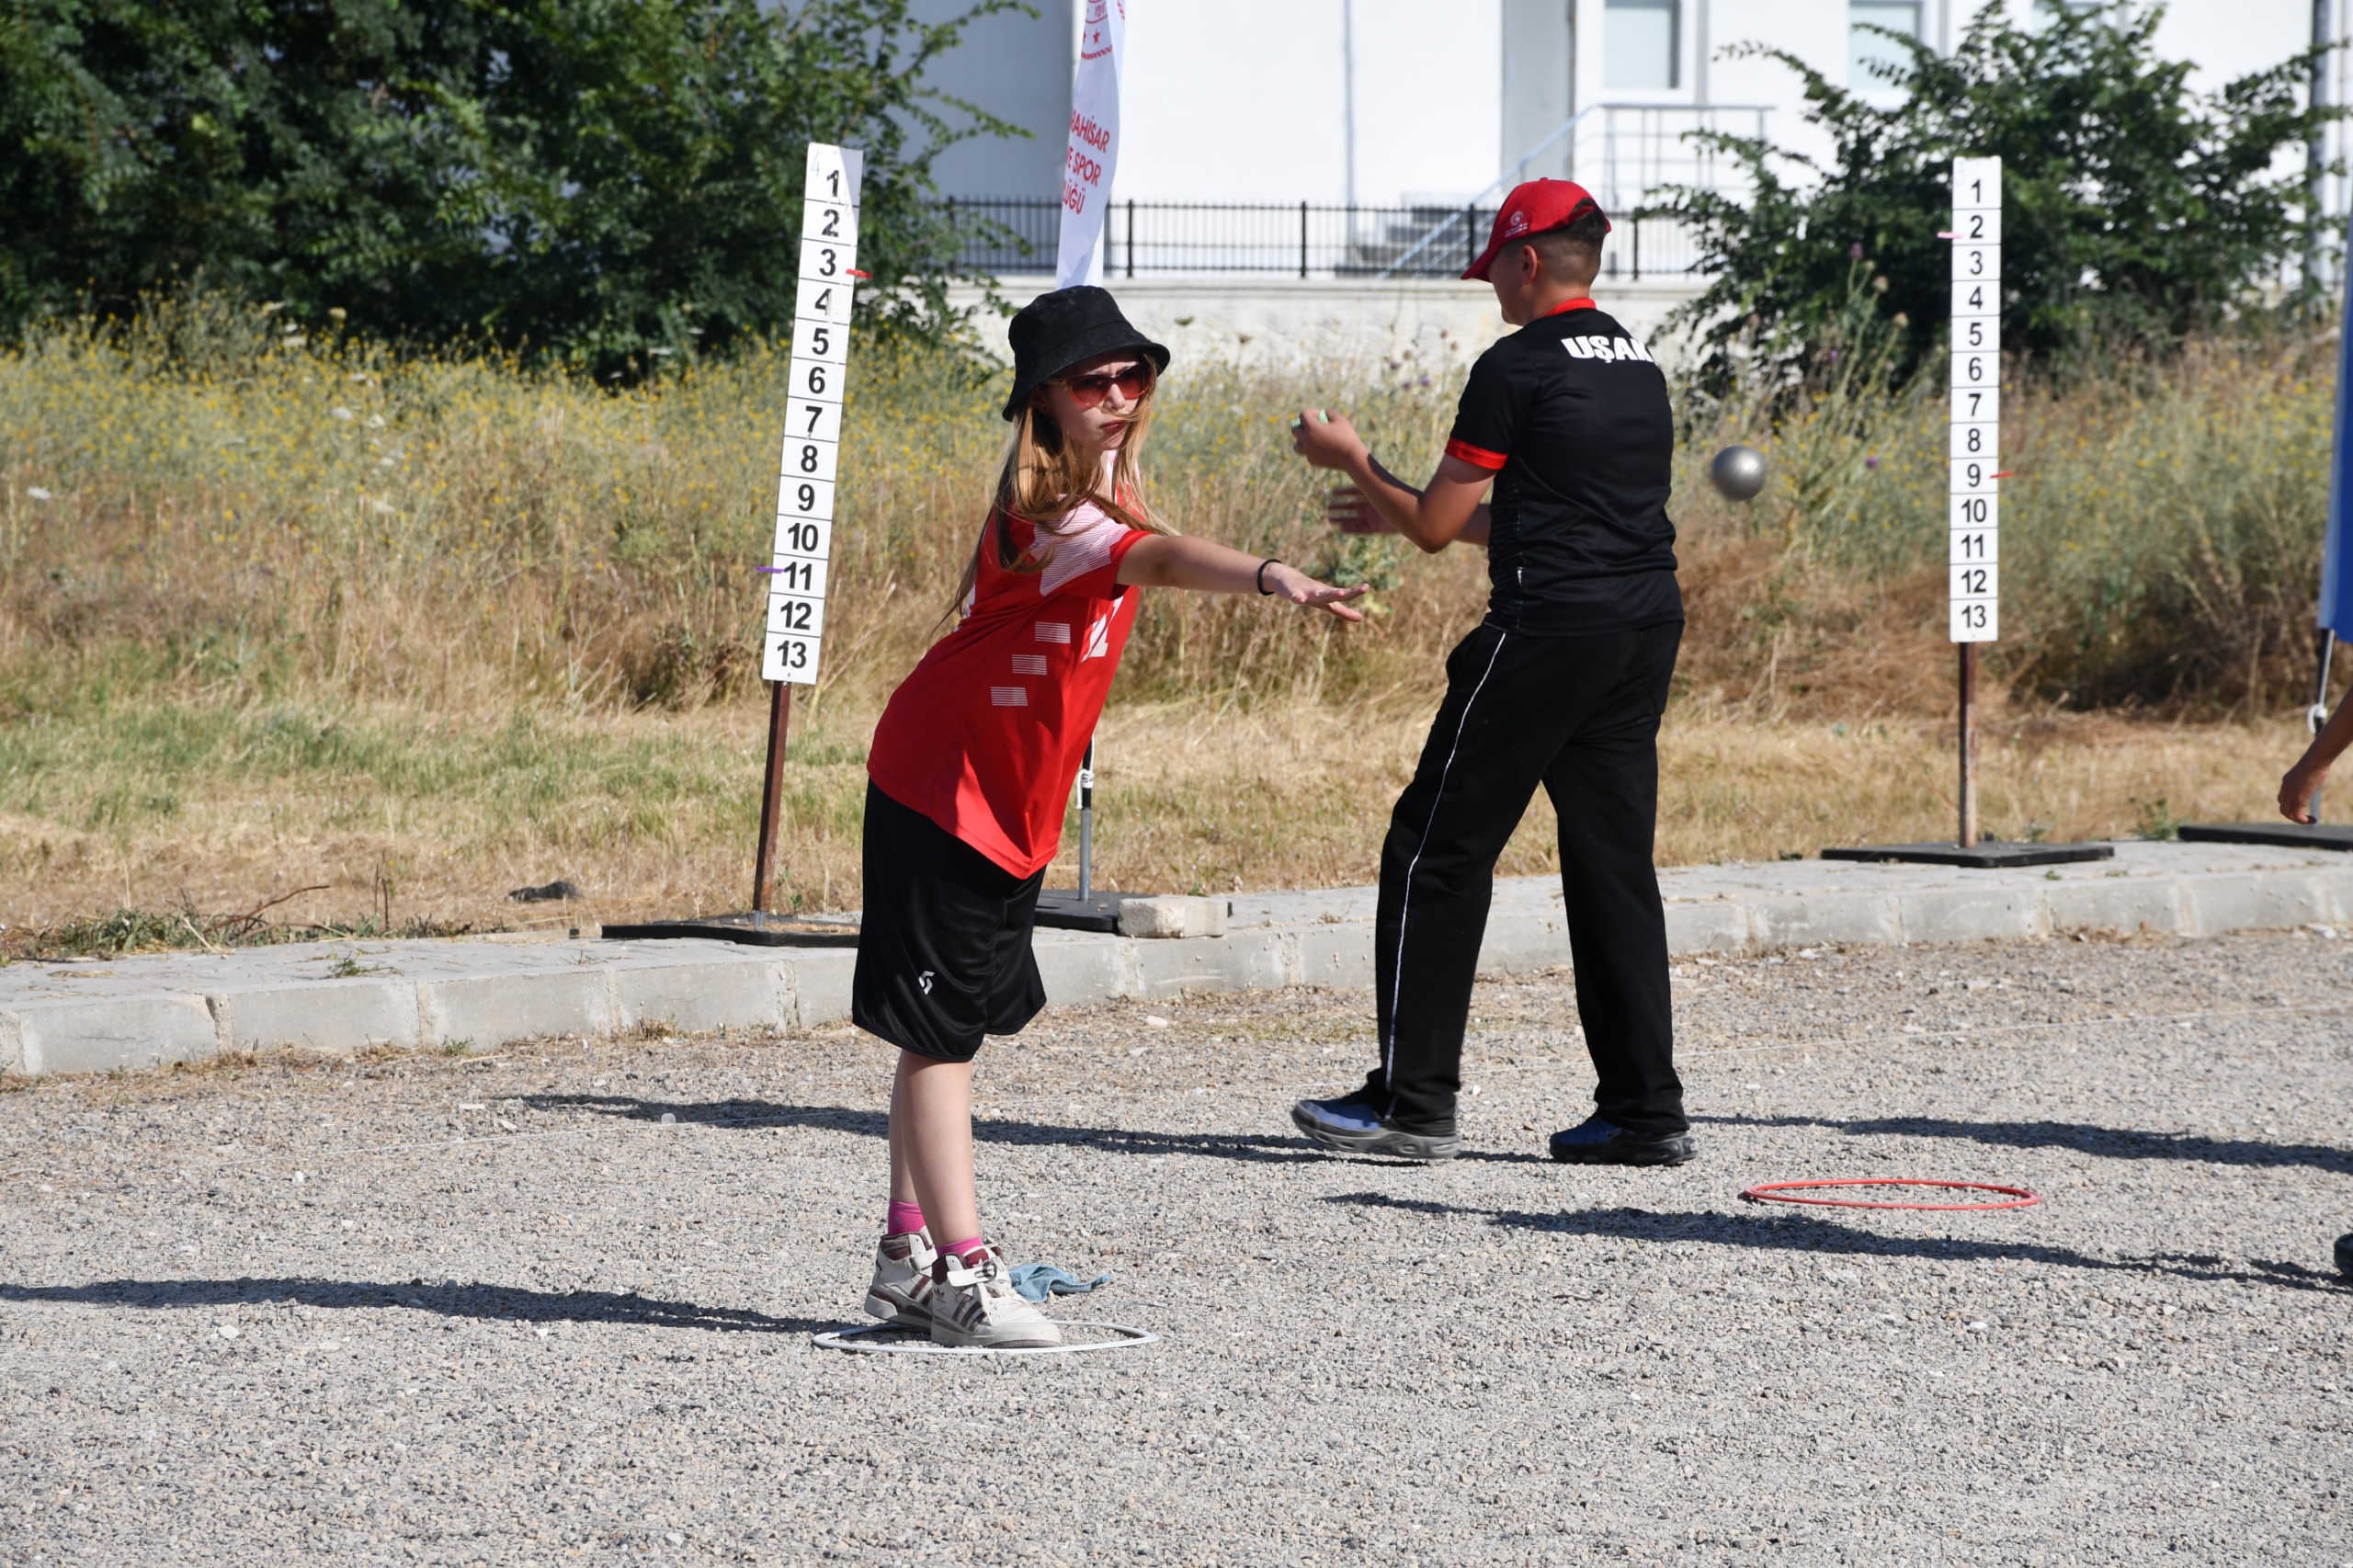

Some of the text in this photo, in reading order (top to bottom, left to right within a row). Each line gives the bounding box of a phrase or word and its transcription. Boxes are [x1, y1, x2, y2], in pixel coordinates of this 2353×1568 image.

[1073, 152, 1102, 187] SPOR
[826, 169, 839, 198] 1
[1971, 179, 1981, 203] 1
[821, 209, 840, 238] 2
[1970, 214, 1984, 239] 2
[819, 248, 836, 277] 3
[1970, 250, 1984, 276] 3
[814, 288, 833, 315] 4
[1968, 286, 1984, 310] 4
[812, 327, 829, 356] 5
[1969, 322, 1983, 347] 5
[1560, 335, 1654, 363] UŞAK
[808, 366, 826, 394] 6
[1968, 357, 1983, 381] 6
[1968, 392, 1982, 416] 7
[805, 404, 824, 434] 7
[1967, 427, 1982, 452] 8
[800, 444, 818, 473] 8
[1967, 463, 1981, 488] 9
[797, 483, 815, 512] 9
[1961, 498, 1987, 523] 10
[787, 522, 819, 552] 10
[1961, 533, 1984, 558] 11
[783, 561, 813, 591] 11
[1961, 569, 1987, 594] 12
[779, 600, 813, 631] 12
[1961, 604, 1986, 629] 13
[777, 640, 807, 669] 13
